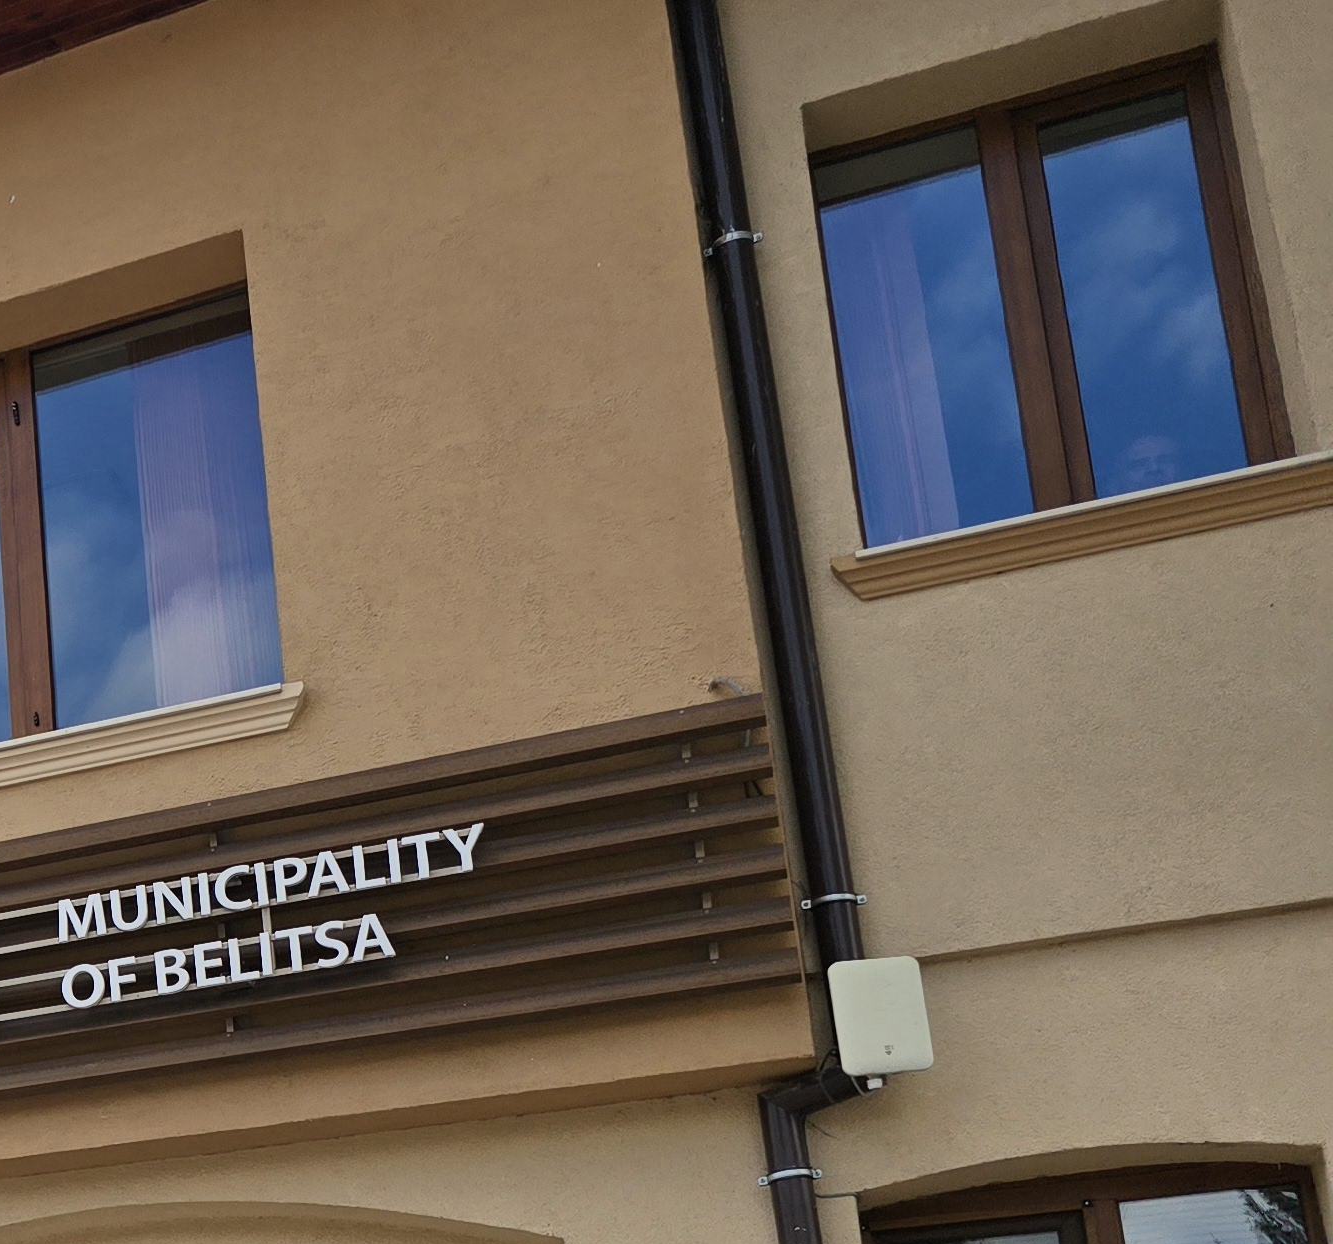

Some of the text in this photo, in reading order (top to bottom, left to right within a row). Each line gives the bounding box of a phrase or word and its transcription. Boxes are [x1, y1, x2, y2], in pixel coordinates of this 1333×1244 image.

[57, 822, 485, 943] MUNICIPALITY
[60, 913, 397, 1010] OF BELITSA
